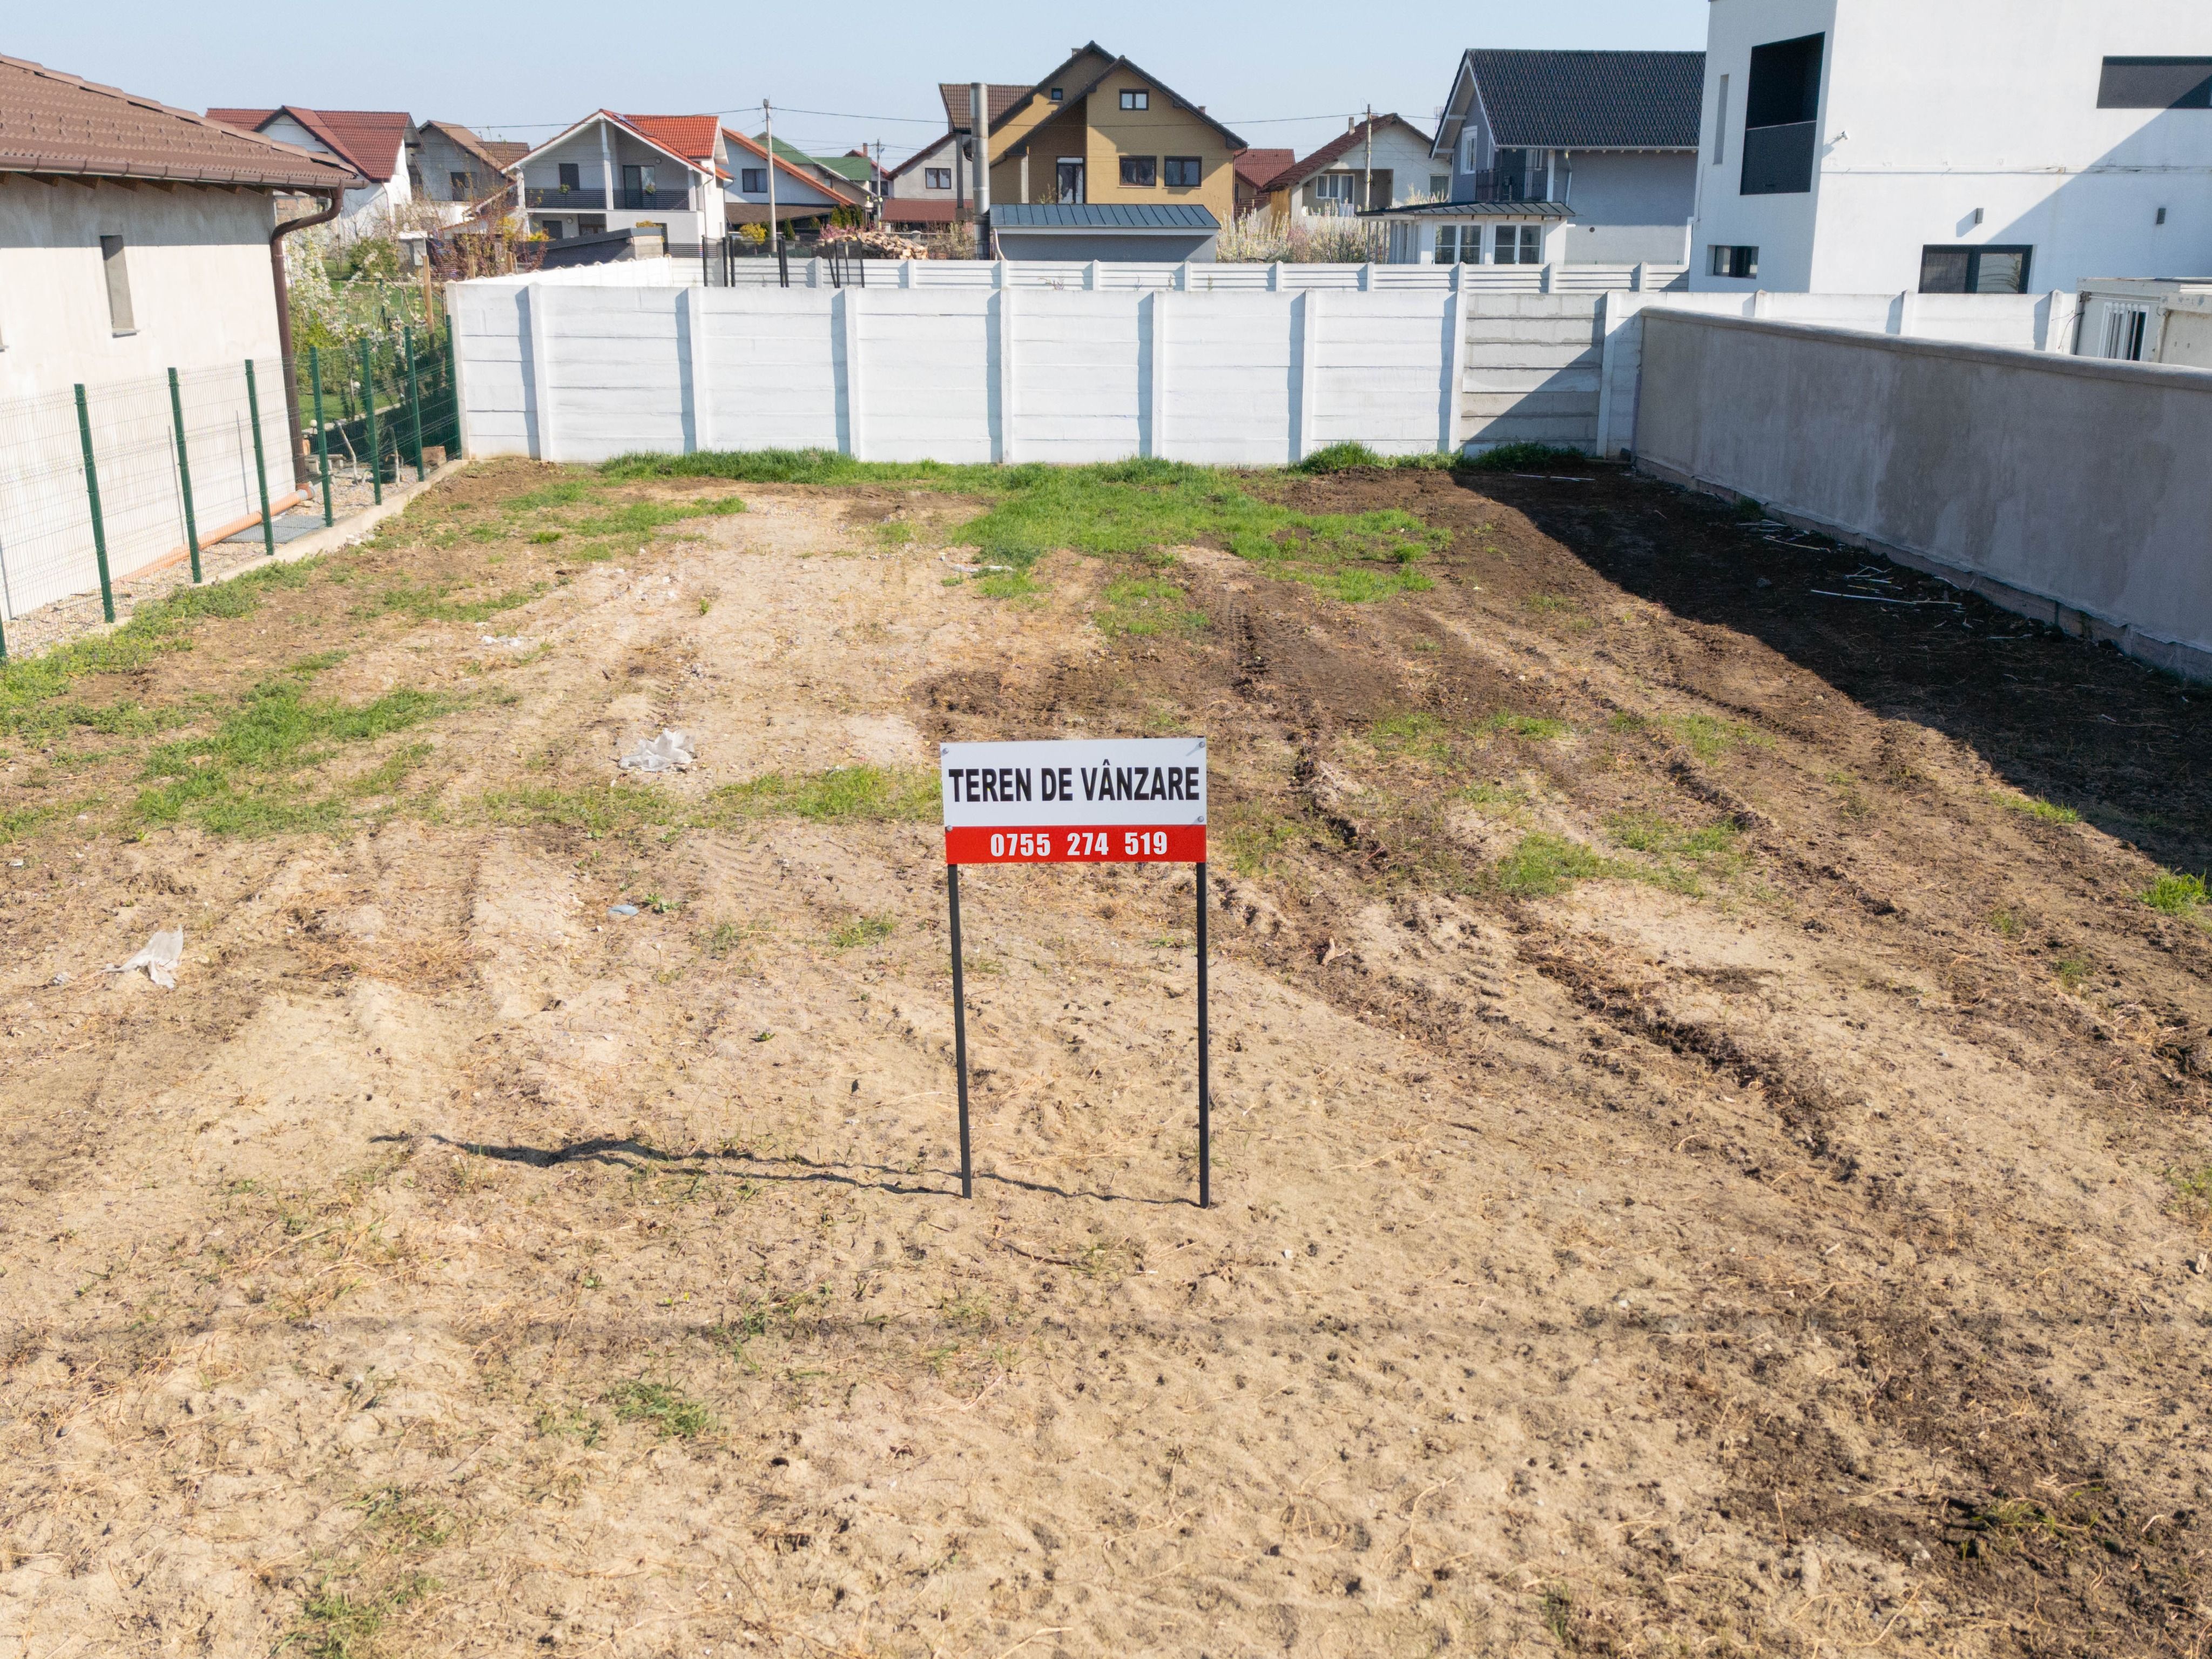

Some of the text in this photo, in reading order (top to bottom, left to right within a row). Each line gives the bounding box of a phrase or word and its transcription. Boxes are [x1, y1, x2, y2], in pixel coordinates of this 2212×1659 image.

[949, 759, 1199, 802] TEREN DE VÂNZARE
[990, 831, 1167, 857] 0755 274 519
